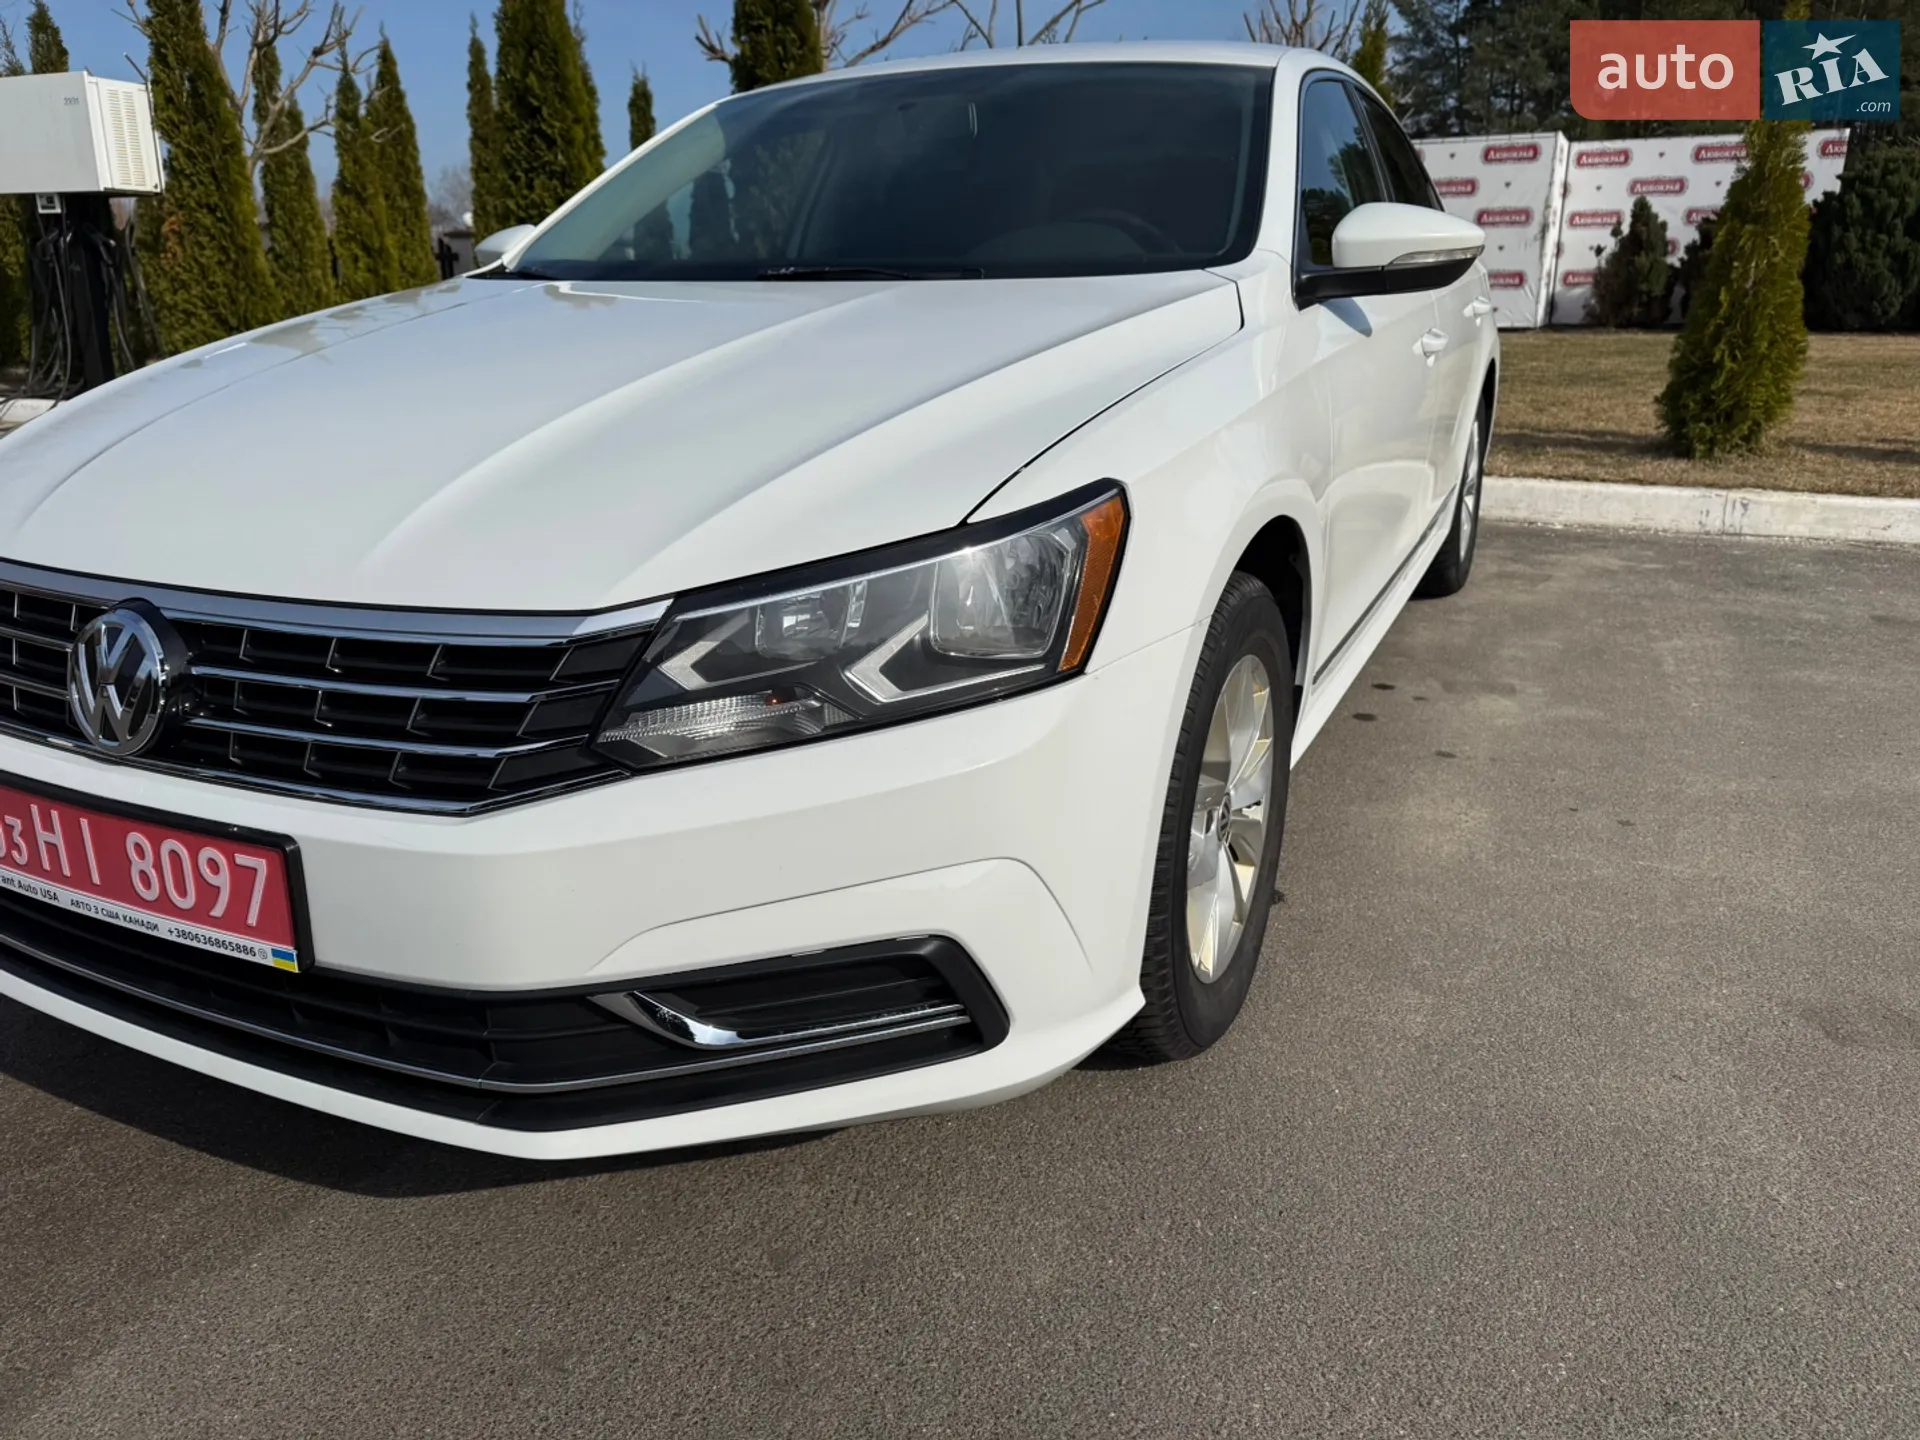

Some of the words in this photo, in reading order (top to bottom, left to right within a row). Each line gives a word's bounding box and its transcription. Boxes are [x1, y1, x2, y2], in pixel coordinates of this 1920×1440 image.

[18, 880, 39, 895] Auto
[40, 888, 60, 902] USA
[126, 832, 267, 928] 8097
[70, 898, 92, 912] АВТО
[101, 908, 121, 920] США
[122, 914, 159, 932] КАНАДИ
[167, 927, 257, 957] +380636865886
